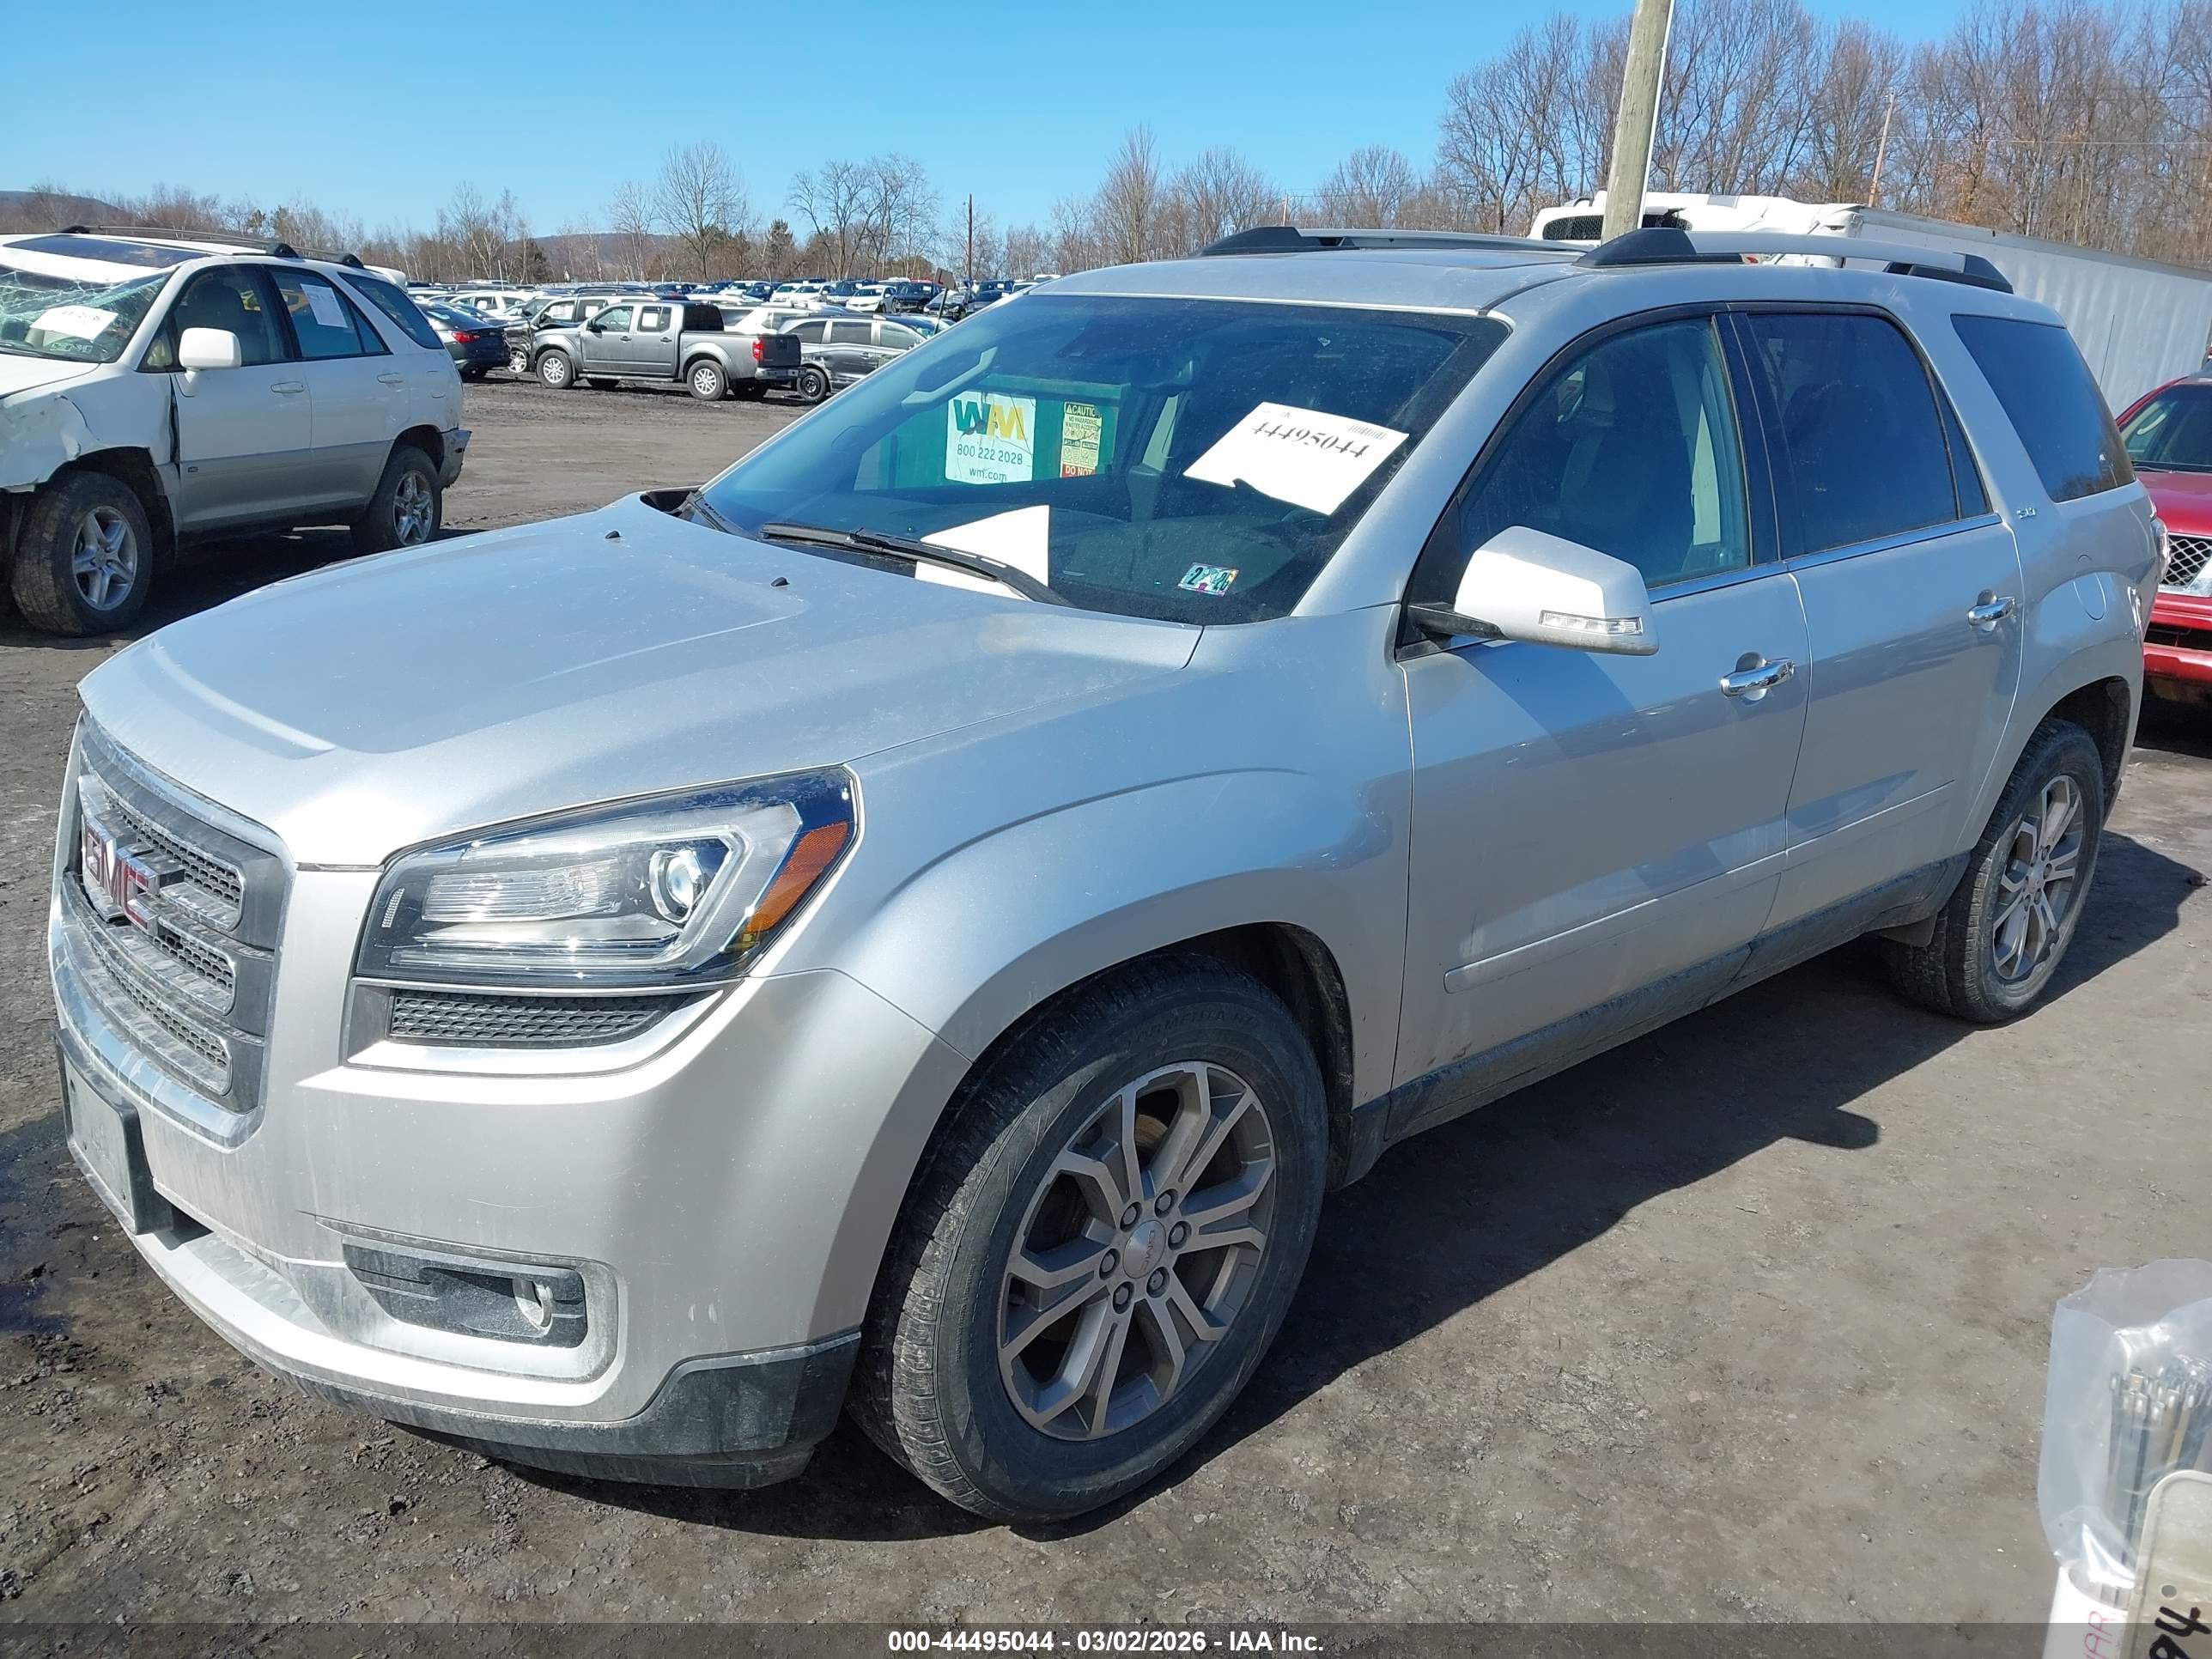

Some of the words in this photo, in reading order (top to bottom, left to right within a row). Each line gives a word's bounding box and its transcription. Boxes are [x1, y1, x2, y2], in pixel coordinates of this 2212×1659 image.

[953, 398, 1024, 441] WM
[1252, 422, 1370, 458] 44495044
[957, 444, 975, 458] 800
[978, 447, 995, 461] 222
[999, 450, 1023, 465] 2028
[969, 468, 1007, 483] wm.com
[1065, 465, 1076, 476] DO
[1078, 467, 1093, 477] NOT
[84, 818, 157, 936] GMC
